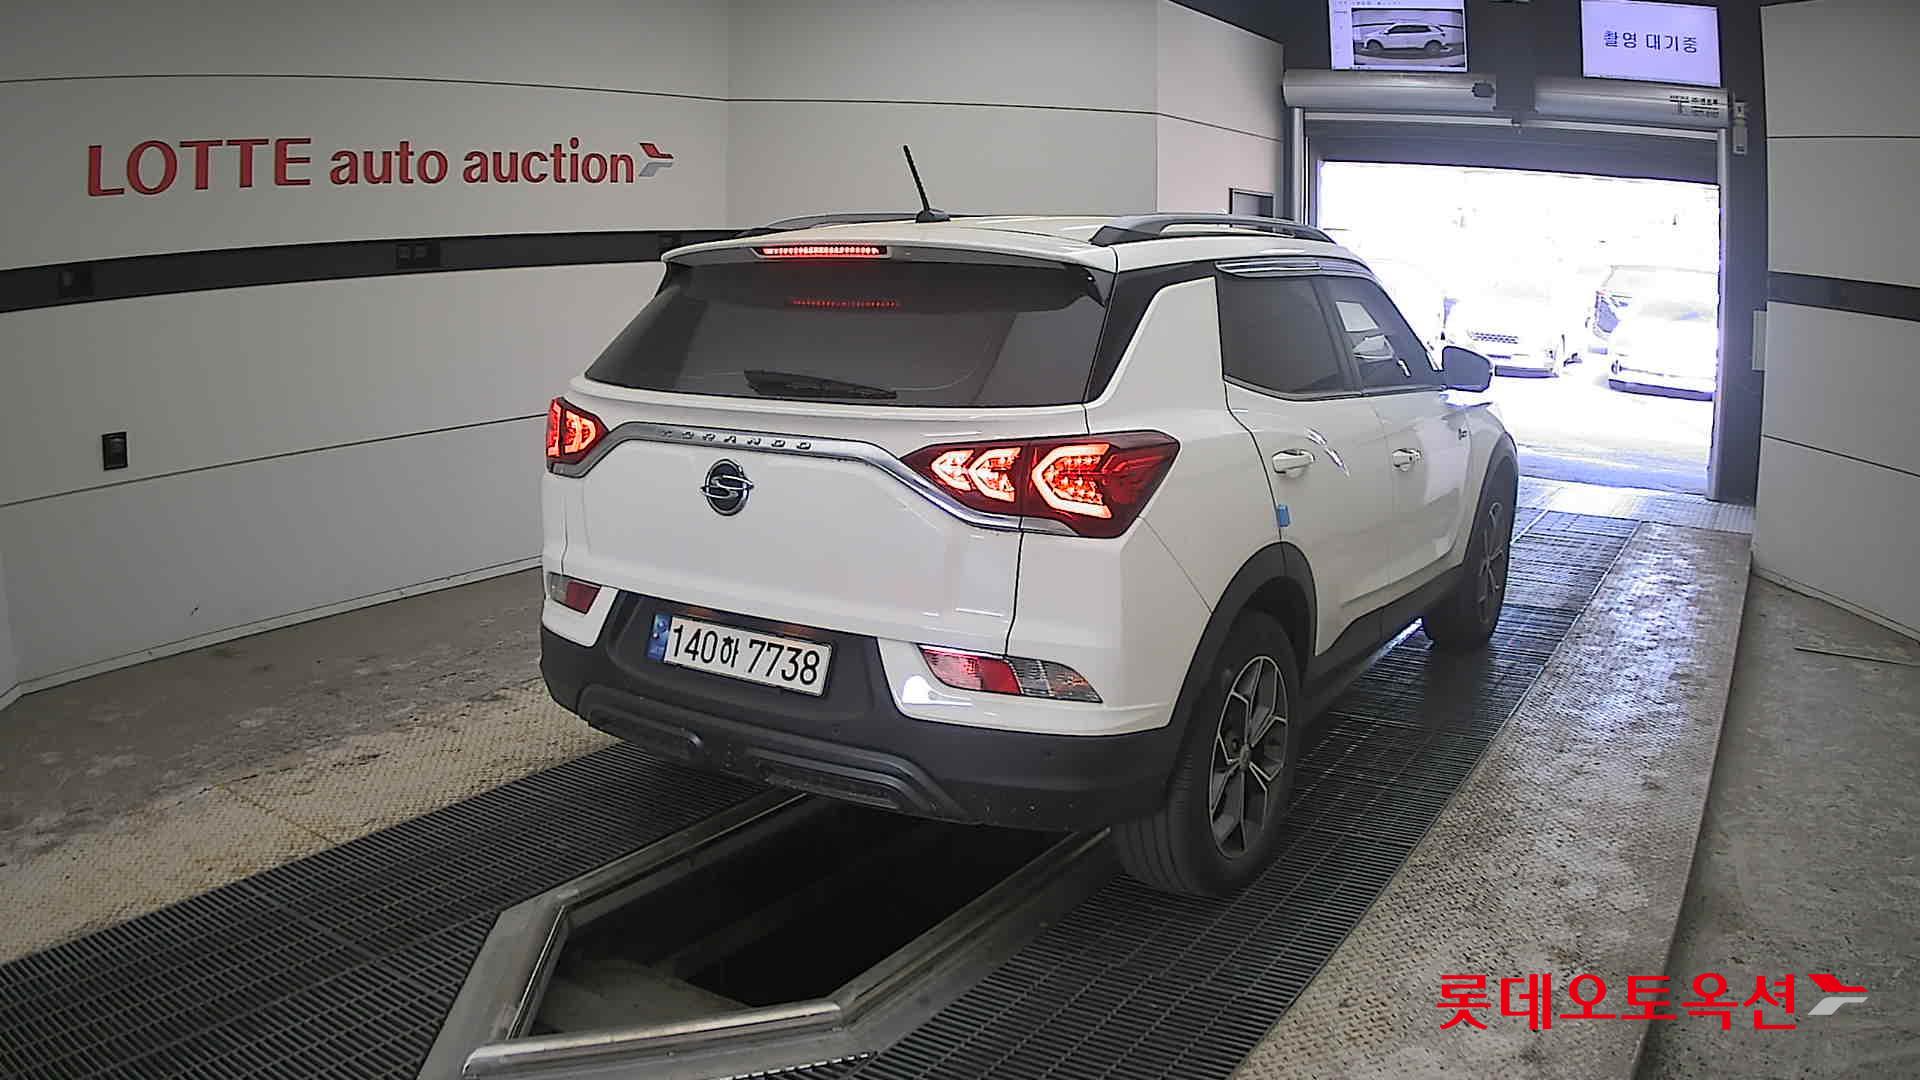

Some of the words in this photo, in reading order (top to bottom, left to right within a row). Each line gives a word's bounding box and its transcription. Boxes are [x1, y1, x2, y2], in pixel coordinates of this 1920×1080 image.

[1645, 33, 1697, 53] 대기중
[87, 137, 312, 197] LOTTE
[329, 140, 448, 185] auto
[463, 137, 635, 185] auction
[673, 624, 740, 668] 140하
[748, 638, 820, 685] 7738
